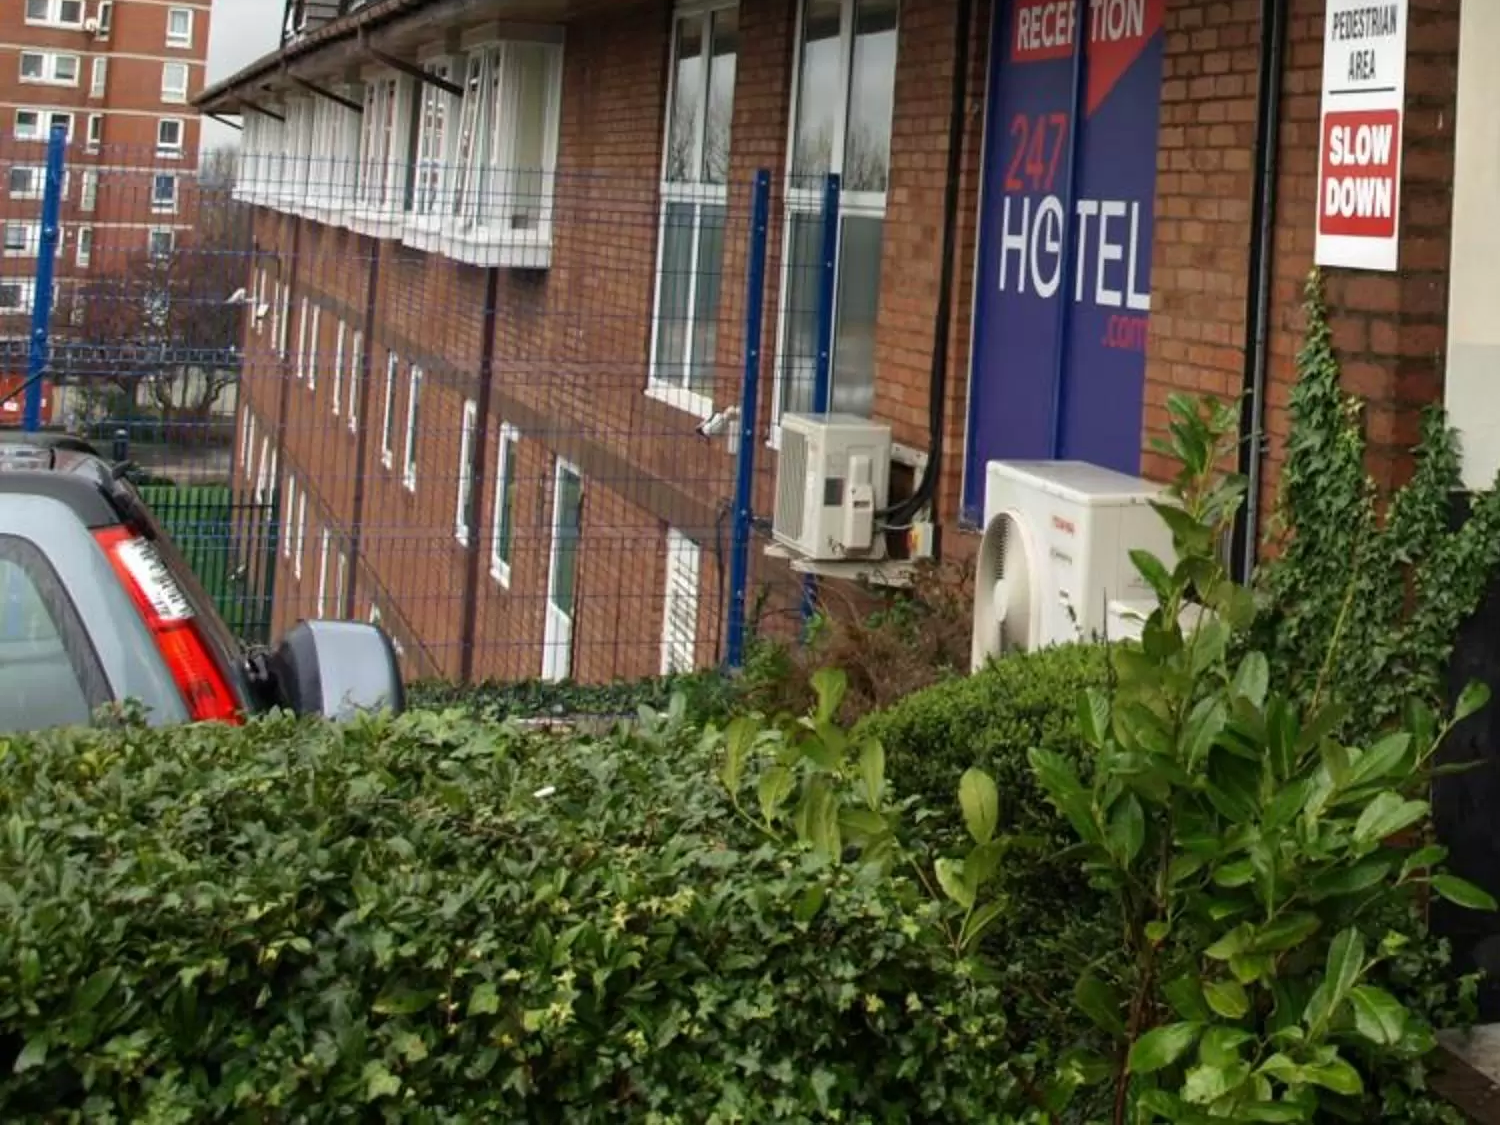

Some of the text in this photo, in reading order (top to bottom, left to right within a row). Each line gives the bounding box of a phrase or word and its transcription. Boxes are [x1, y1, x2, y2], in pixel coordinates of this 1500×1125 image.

[1332, 4, 1397, 42] PEDESTRIAN
[1348, 48, 1376, 82] AREA
[1004, 112, 1068, 191] 247
[1329, 124, 1393, 166] SLOW
[1325, 176, 1393, 218] DOWN
[999, 195, 1150, 310] HOTEL
